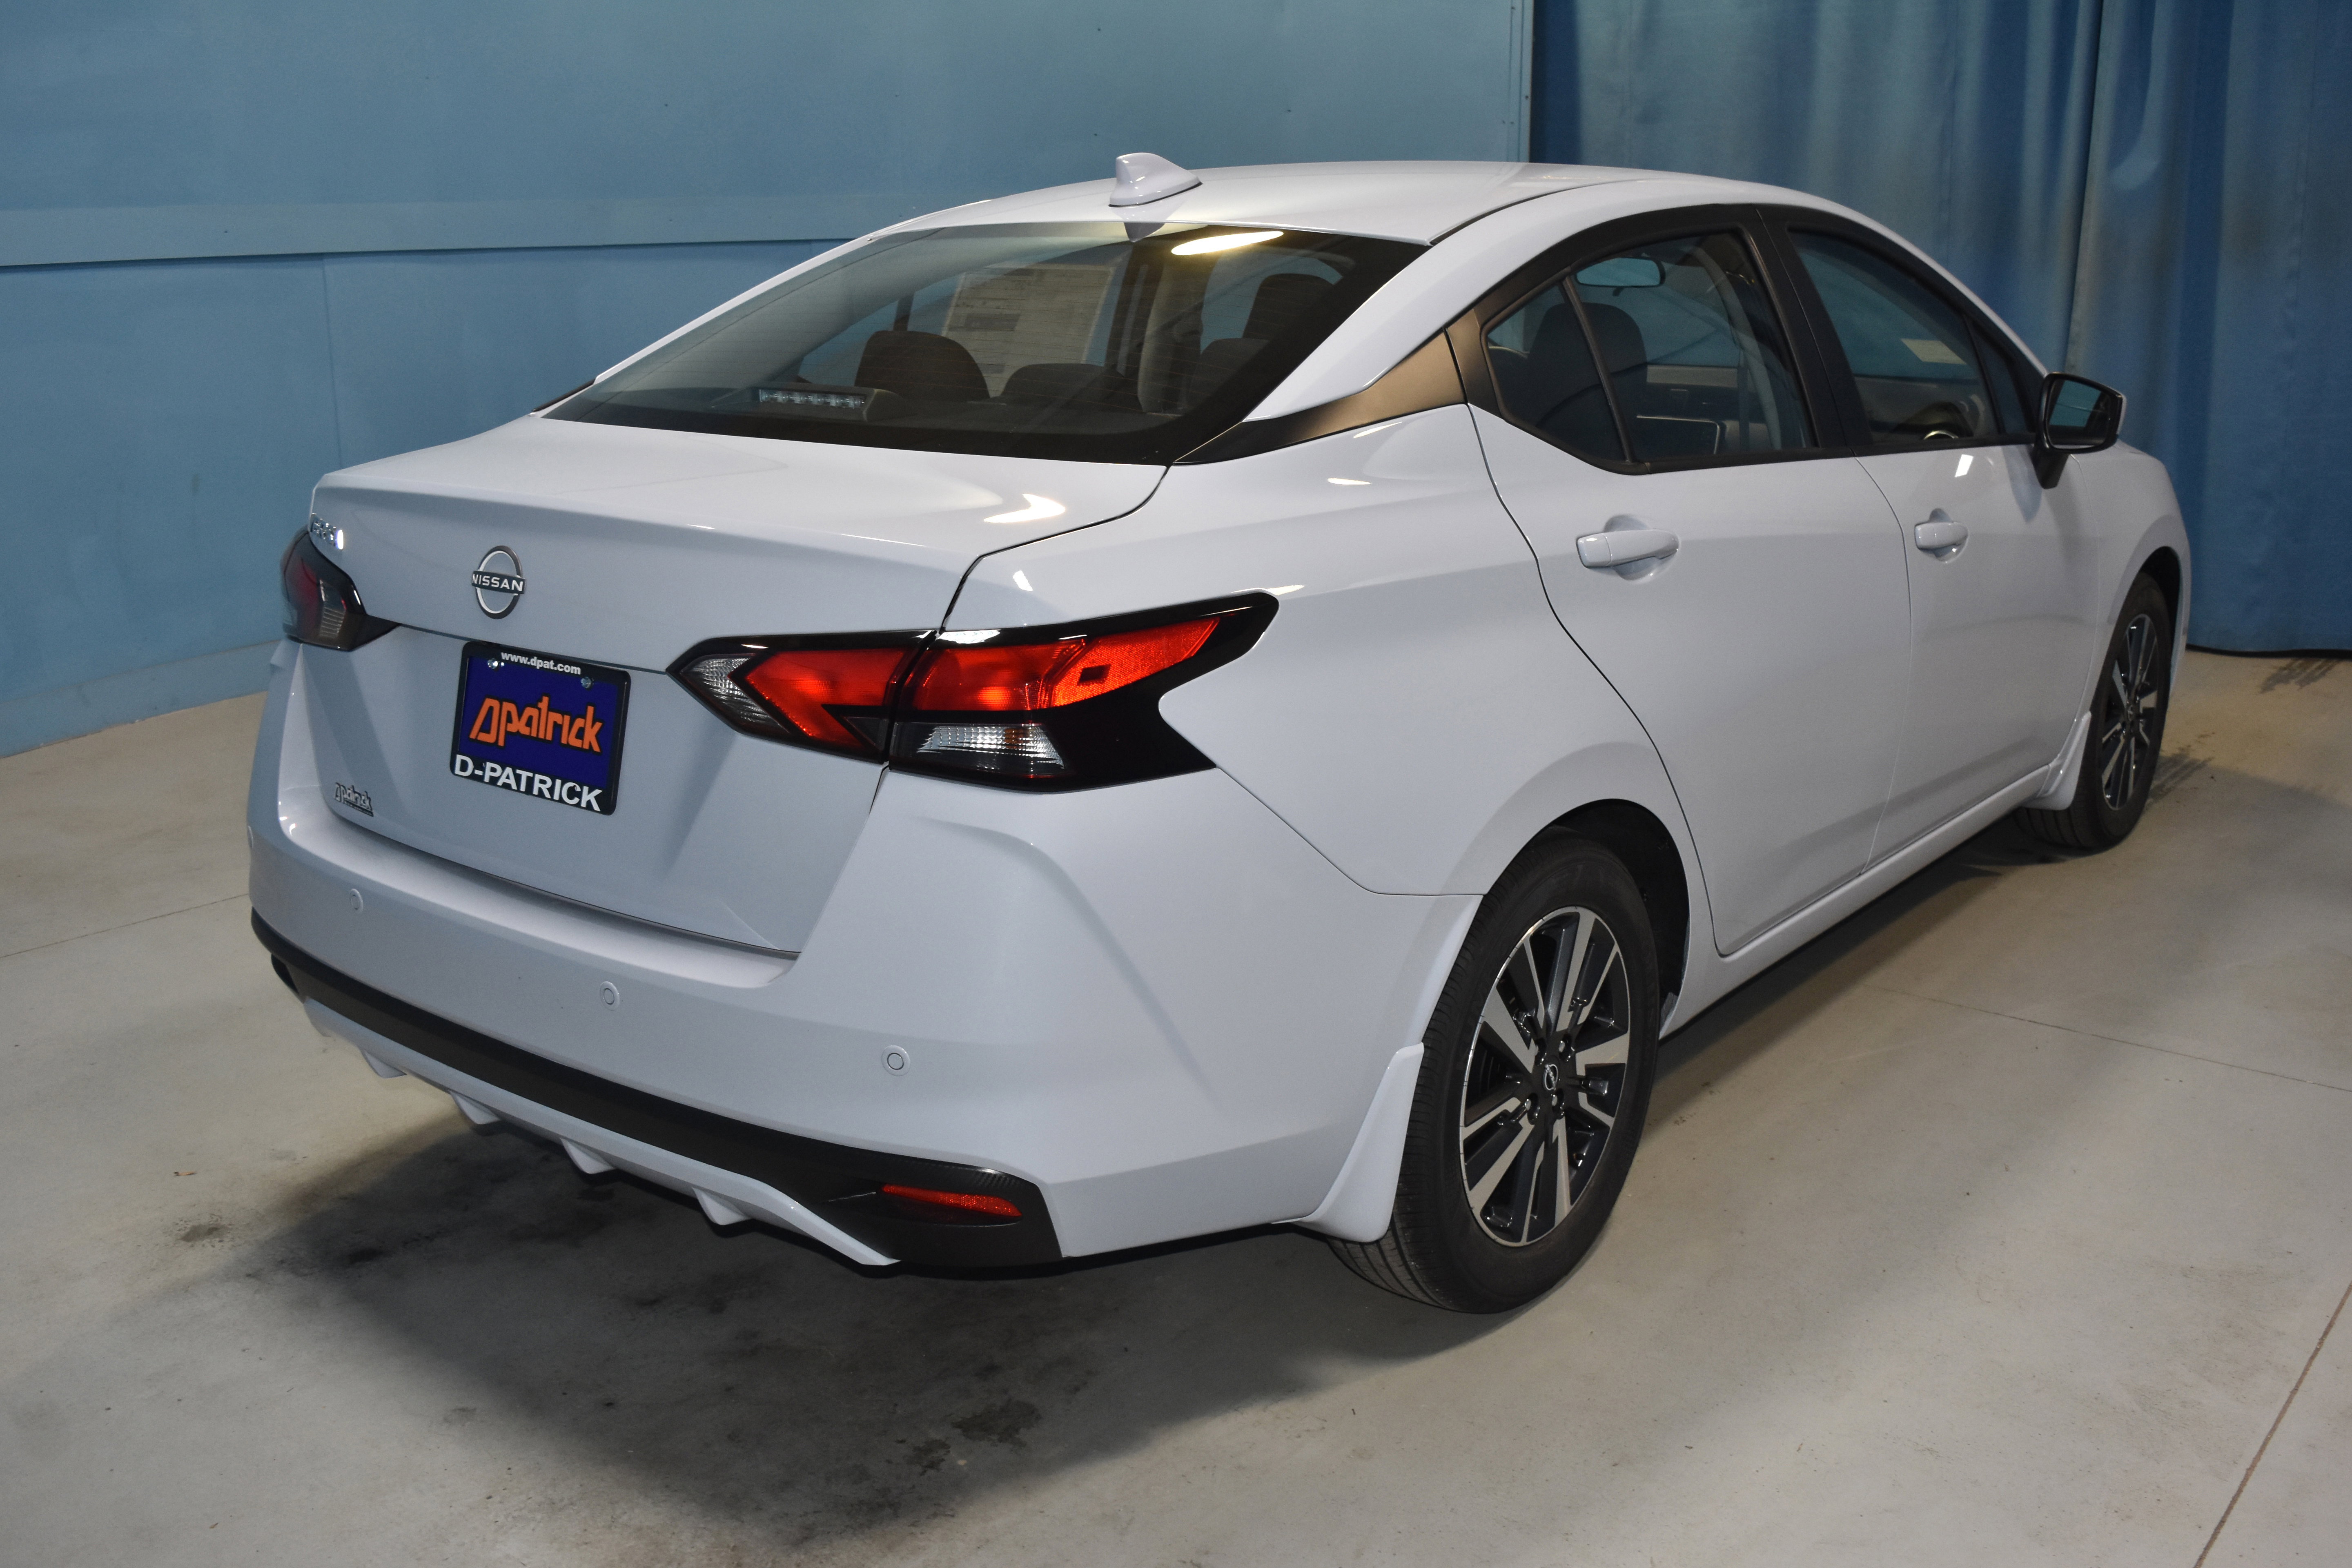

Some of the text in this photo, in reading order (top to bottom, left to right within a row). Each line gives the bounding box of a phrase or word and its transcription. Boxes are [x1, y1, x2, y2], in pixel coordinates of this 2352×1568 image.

[472, 574, 523, 592] NISSAN
[501, 652, 581, 675] www.dpat.com
[454, 754, 603, 812] D-PATRICK
